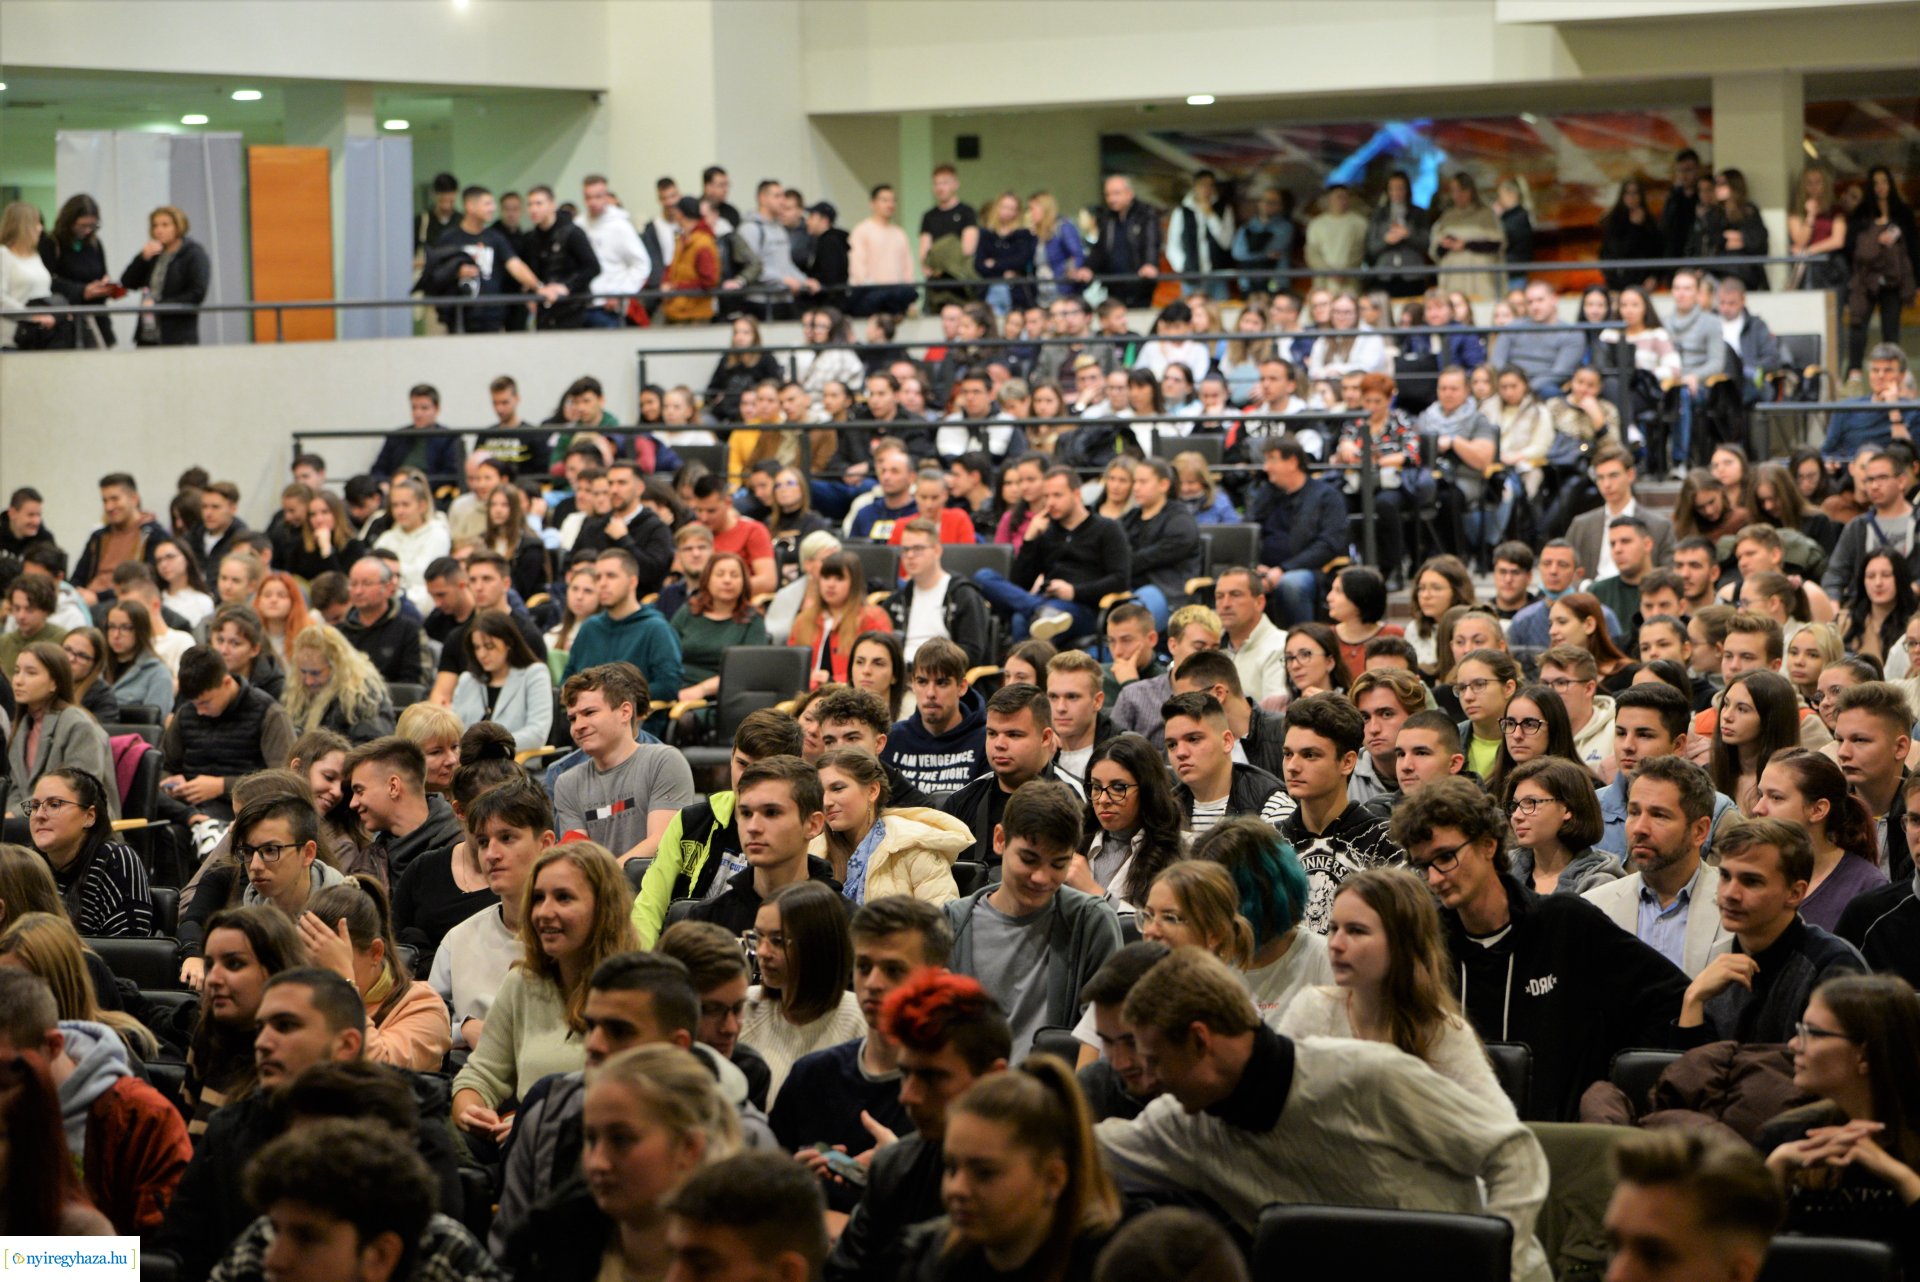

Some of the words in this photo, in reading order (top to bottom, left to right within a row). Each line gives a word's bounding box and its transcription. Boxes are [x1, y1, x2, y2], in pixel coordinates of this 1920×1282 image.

[893, 752, 900, 763] I
[900, 754, 917, 767] AM
[918, 771, 938, 781] THE
